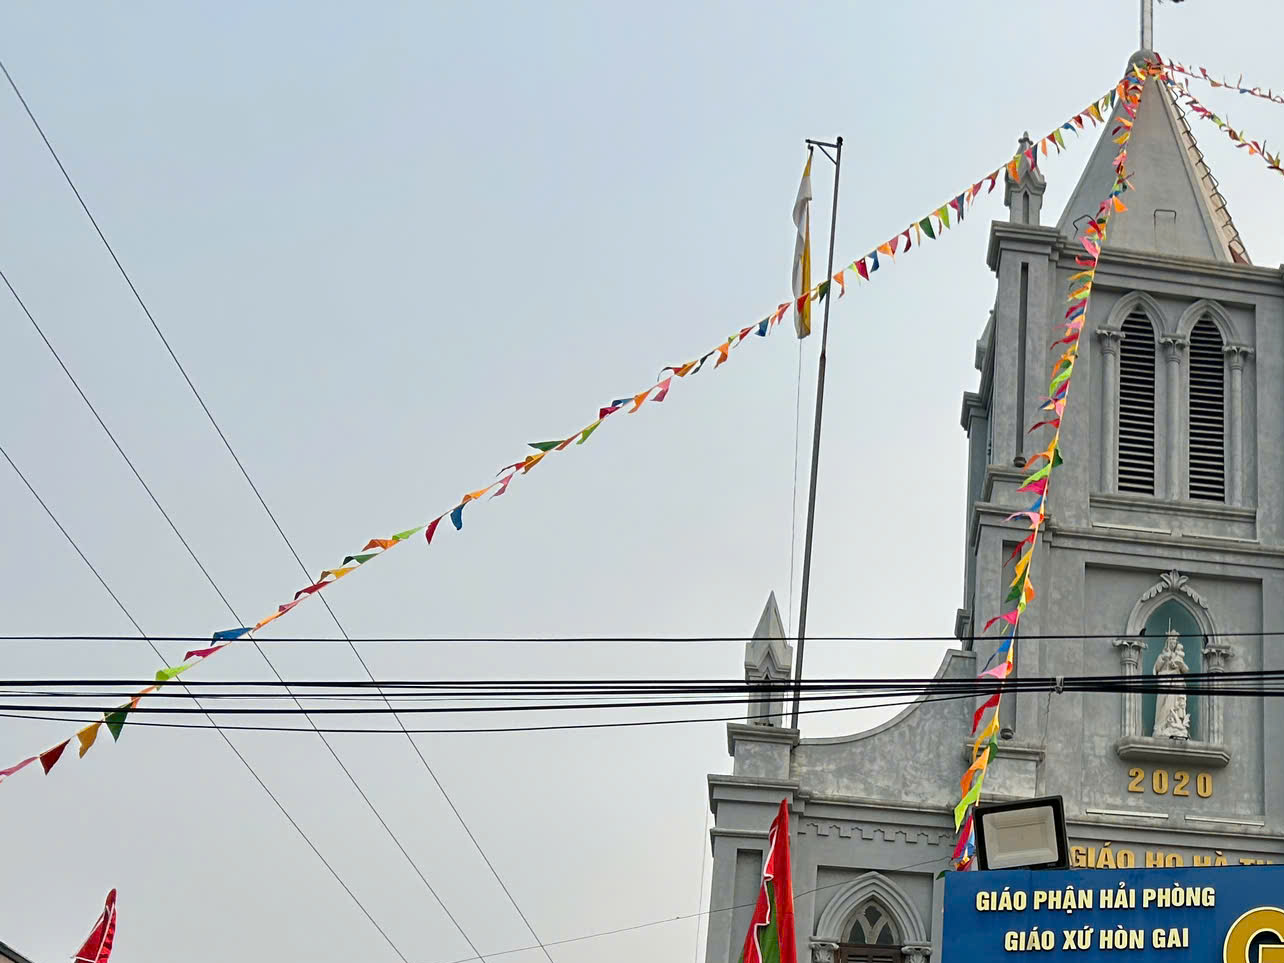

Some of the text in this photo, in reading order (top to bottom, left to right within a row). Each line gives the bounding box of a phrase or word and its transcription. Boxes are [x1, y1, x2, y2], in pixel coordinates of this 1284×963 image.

[1128, 767, 1213, 798] 2020
[1070, 841, 1136, 869] GIÁO
[975, 881, 1216, 914] GIÁO PHẬN HẢI PHÒNG
[1004, 924, 1189, 951] GIÁO XỨ HÒN GAI
